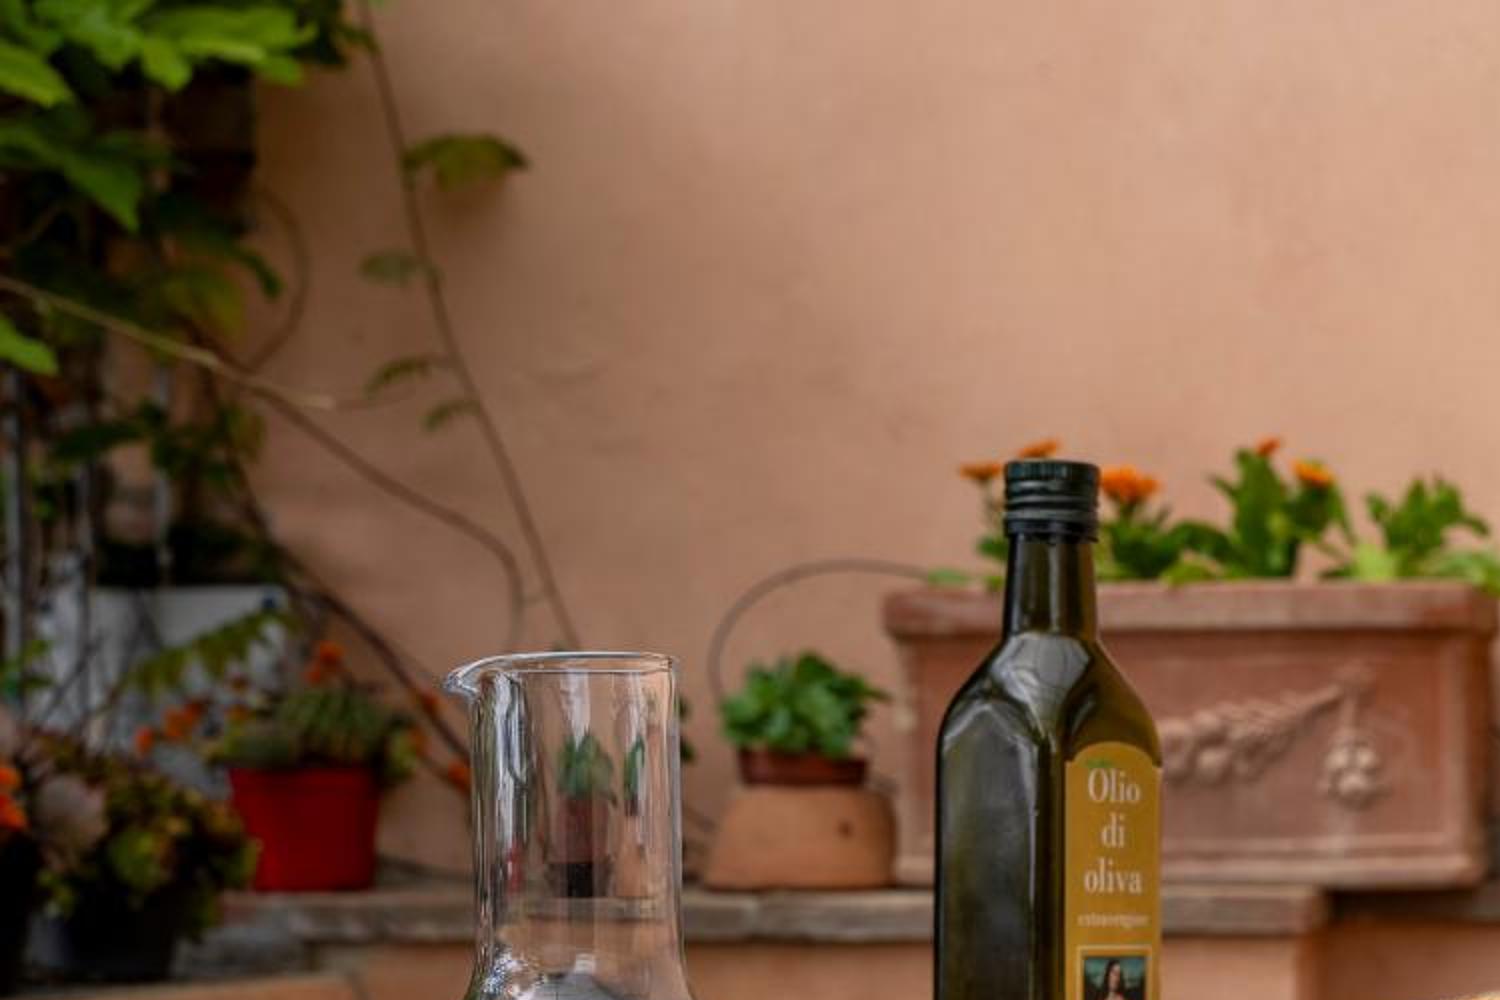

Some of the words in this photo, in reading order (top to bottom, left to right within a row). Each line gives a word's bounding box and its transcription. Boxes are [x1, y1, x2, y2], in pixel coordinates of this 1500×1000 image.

[1087, 767, 1141, 803] Olio
[1101, 812, 1125, 848] di
[1084, 857, 1142, 894] oliva
